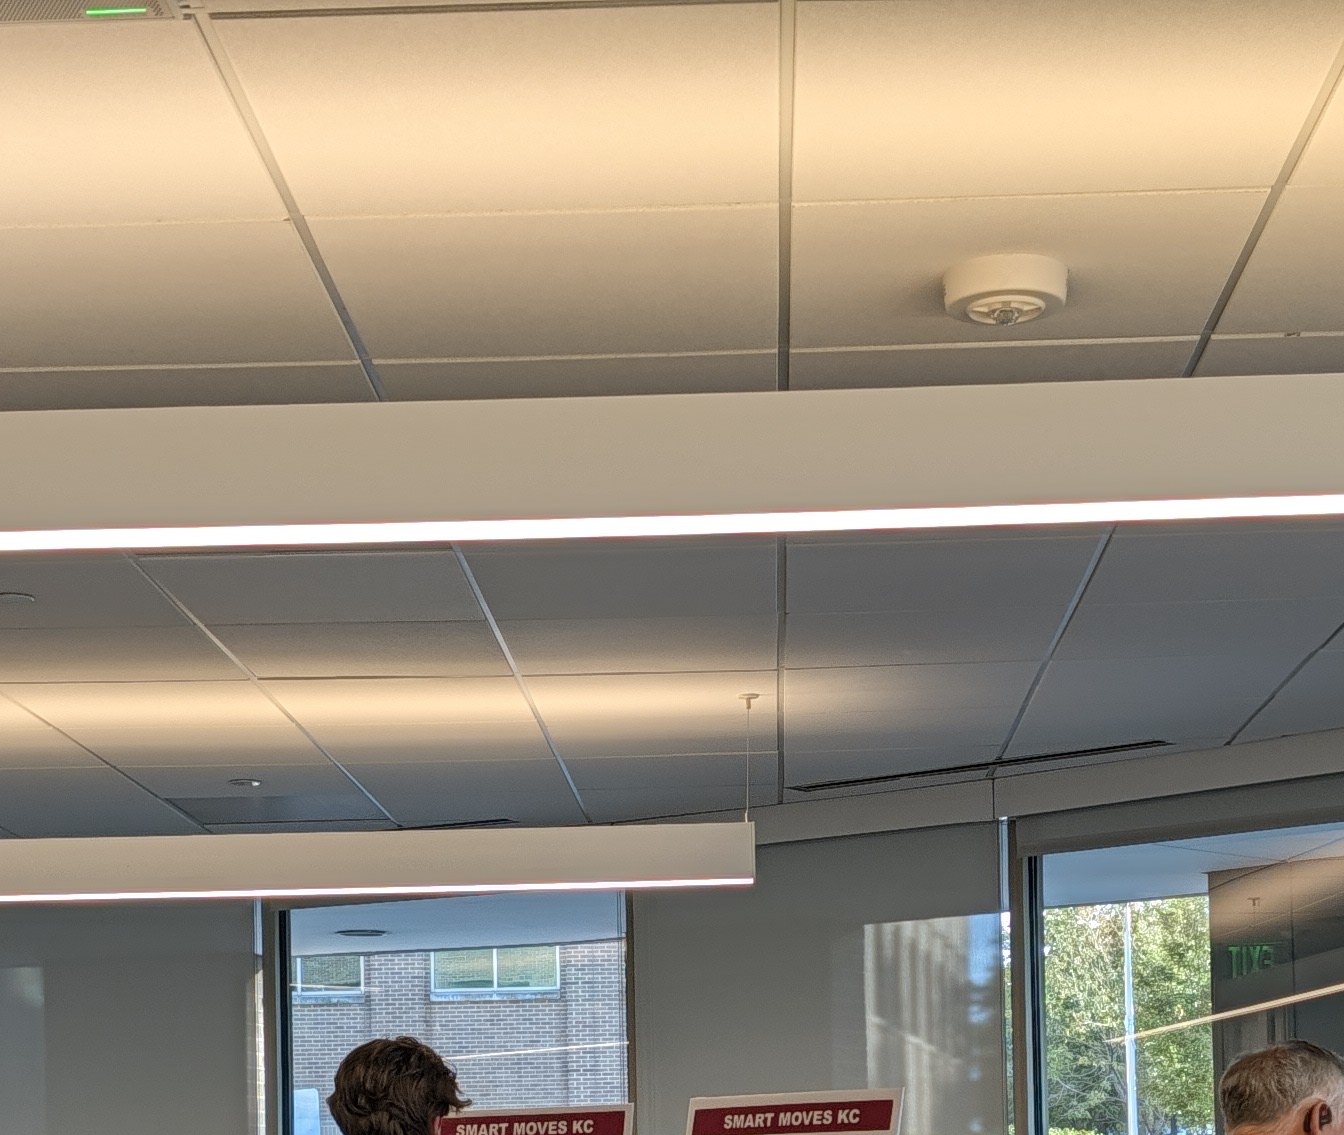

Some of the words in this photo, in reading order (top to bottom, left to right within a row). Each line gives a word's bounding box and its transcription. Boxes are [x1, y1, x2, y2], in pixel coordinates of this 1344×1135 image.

[513, 1122, 567, 1135] MOVES
[572, 1120, 594, 1133] KC
[724, 1113, 775, 1129] SMART
[778, 1110, 832, 1127] MOVES
[837, 1109, 860, 1123] KC
